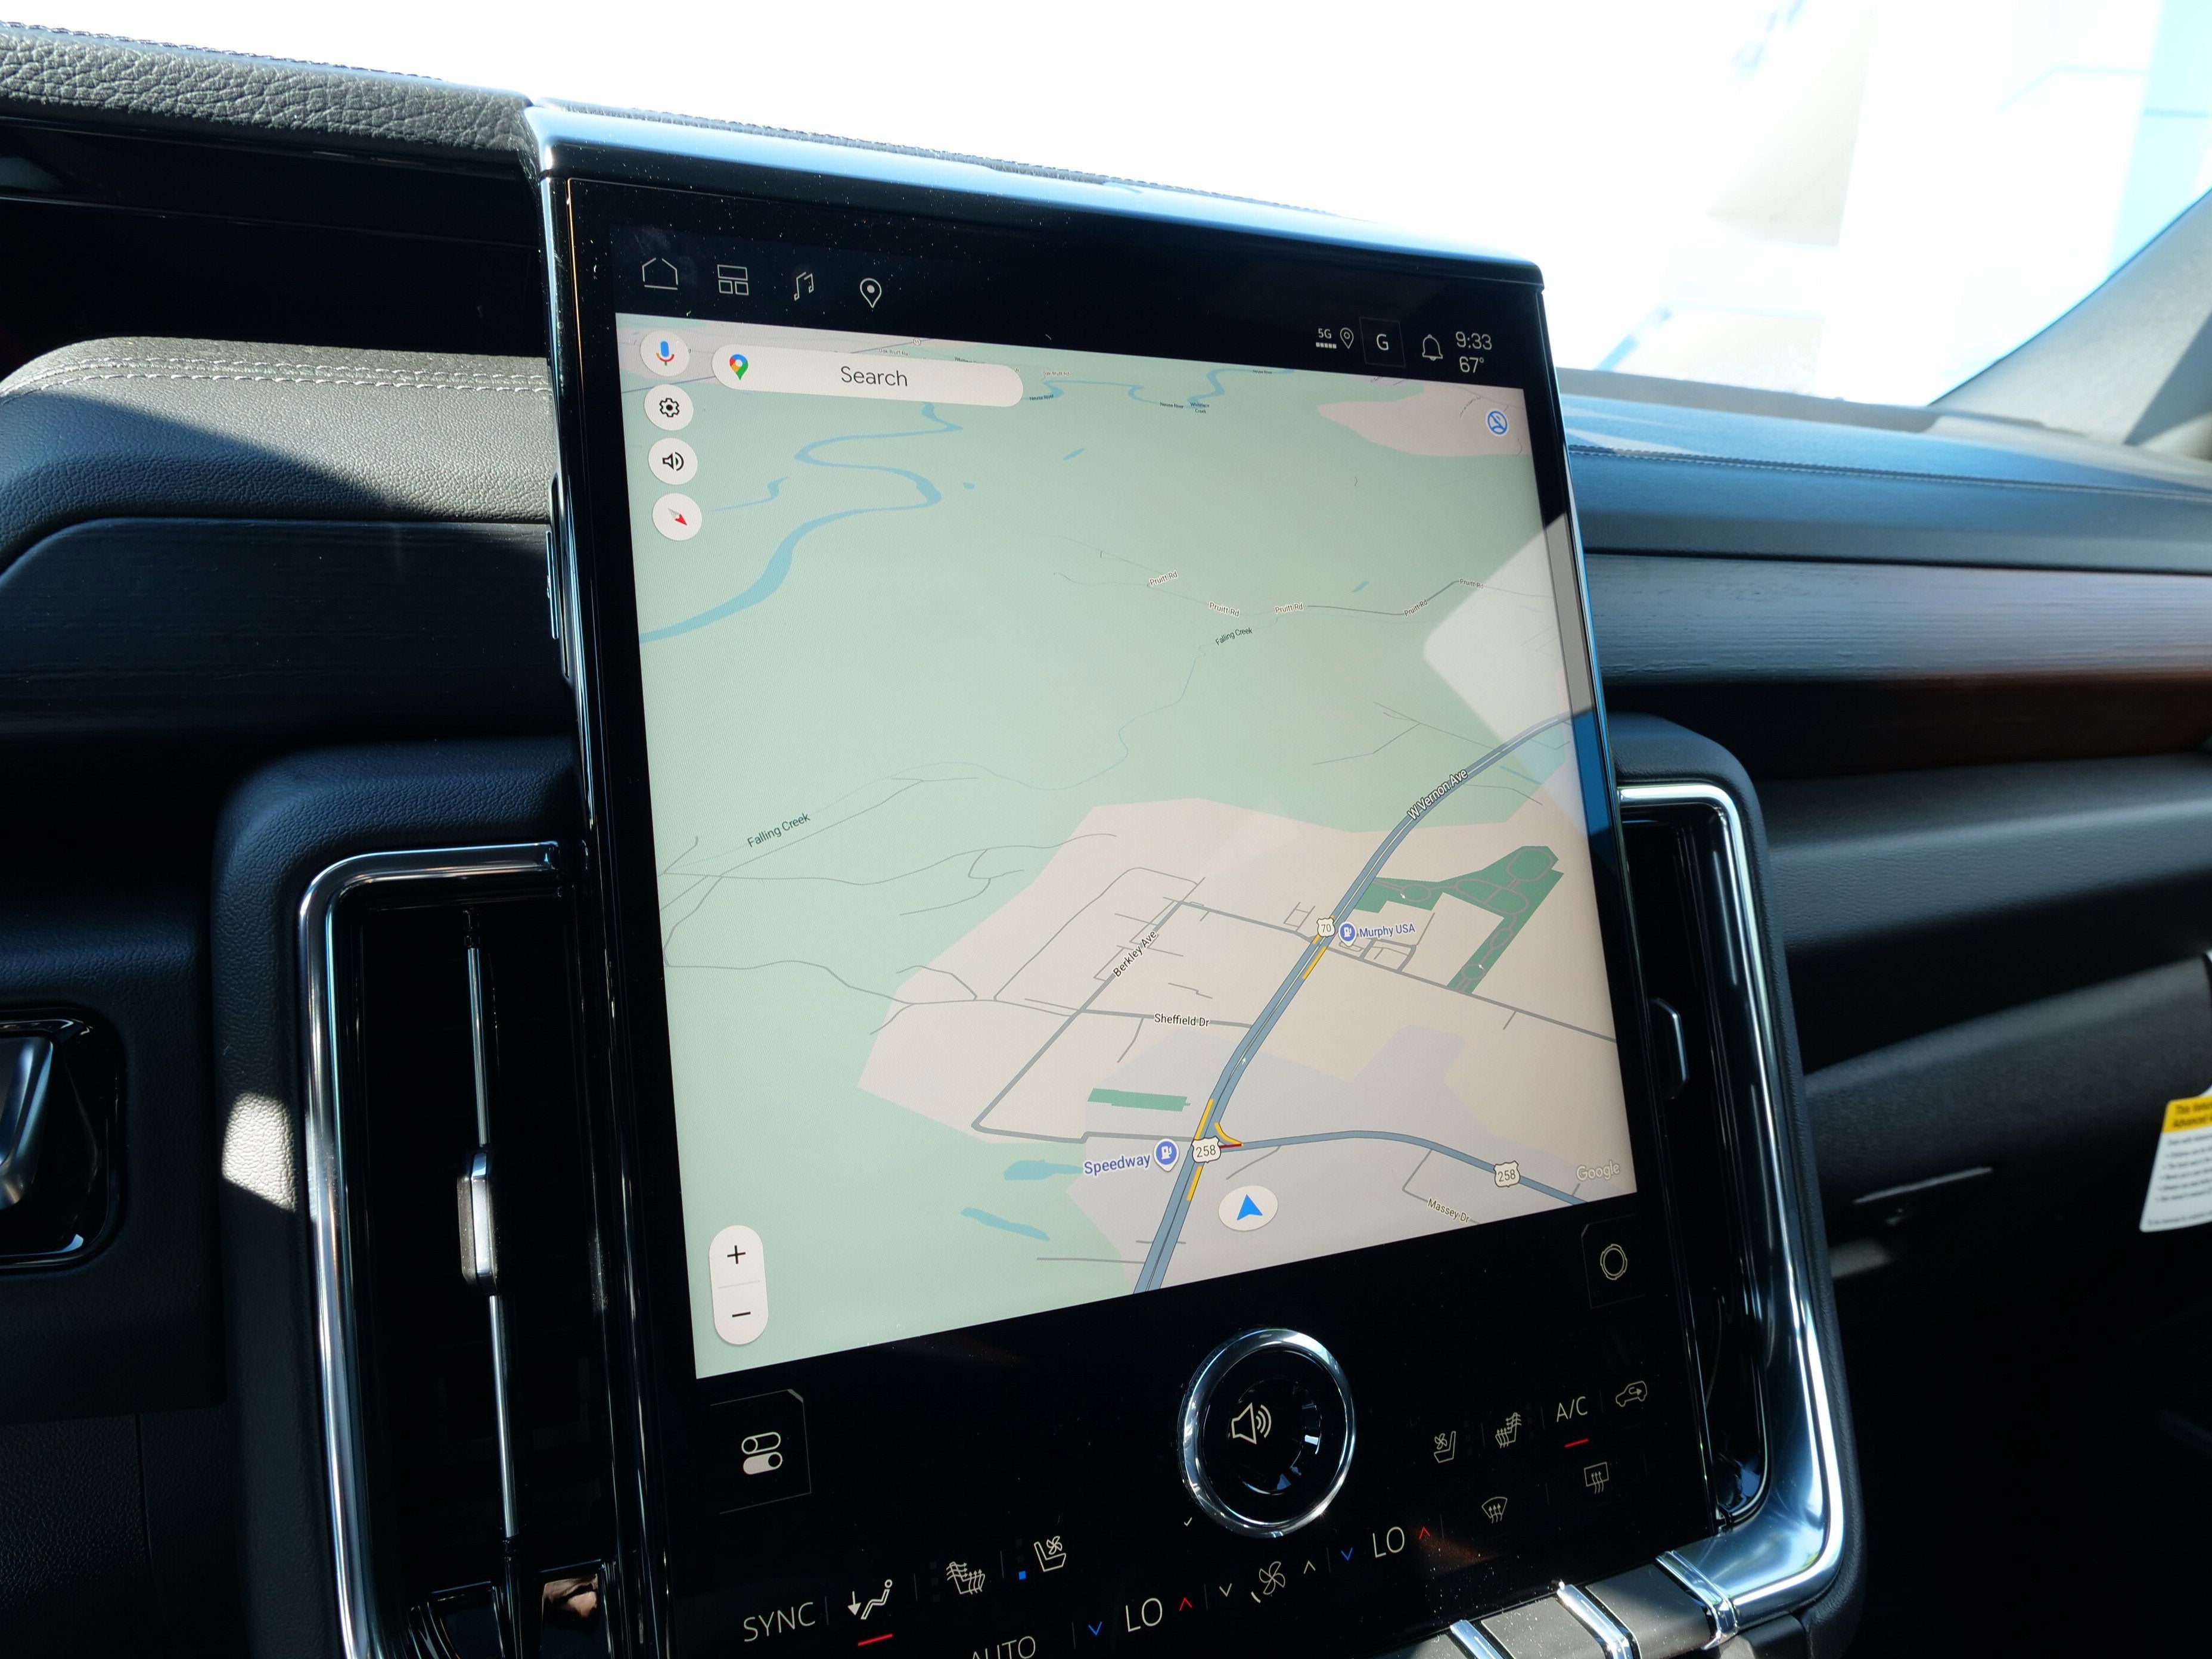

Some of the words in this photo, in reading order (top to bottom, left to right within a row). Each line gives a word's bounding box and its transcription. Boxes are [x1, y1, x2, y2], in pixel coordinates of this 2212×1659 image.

[1318, 328, 1332, 339] 5G
[1376, 333, 1390, 351] G
[1455, 331, 1493, 350] 9:33
[1459, 356, 1485, 374] 67°
[840, 365, 908, 387] Search
[1149, 574, 1168, 586] Pruitt
[1168, 570, 1178, 580] Rd
[1460, 579, 1476, 587] Pruitt
[1209, 601, 1229, 614] Pruitt
[1230, 608, 1239, 617] Rd
[1275, 604, 1293, 614] Pruitt
[1294, 602, 1303, 611] Rd
[1404, 604, 1420, 617] Pruitt
[1419, 599, 1428, 608] Rd
[1215, 630, 1235, 645] Falling
[1235, 627, 1253, 637] Creek
[1406, 804, 1420, 820] W
[1416, 781, 1451, 810] Vernon
[1449, 769, 1468, 787] Ave
[747, 827, 782, 847] Falling
[781, 812, 811, 831] Creek
[1321, 923, 1331, 933] 70
[1359, 926, 1394, 938] Murphy
[1395, 923, 1415, 934] USA
[1113, 946, 1143, 977] Berkley
[1141, 931, 1157, 948] Ave
[1154, 1013, 1196, 1026] Sheffield
[1199, 1017, 1210, 1027] Dr
[1195, 1144, 1217, 1158] 258
[1084, 1154, 1151, 1176] Speedway
[1576, 1161, 1620, 1181] Google
[1497, 1169, 1516, 1182] 258
[1427, 1198, 1459, 1220] Massey
[1459, 1211, 1470, 1223] Dr
[1556, 1396, 1588, 1422] A/C
[1372, 1526, 1405, 1558] LO
[744, 1601, 816, 1642] SYNC
[1125, 1597, 1163, 1632] LO
